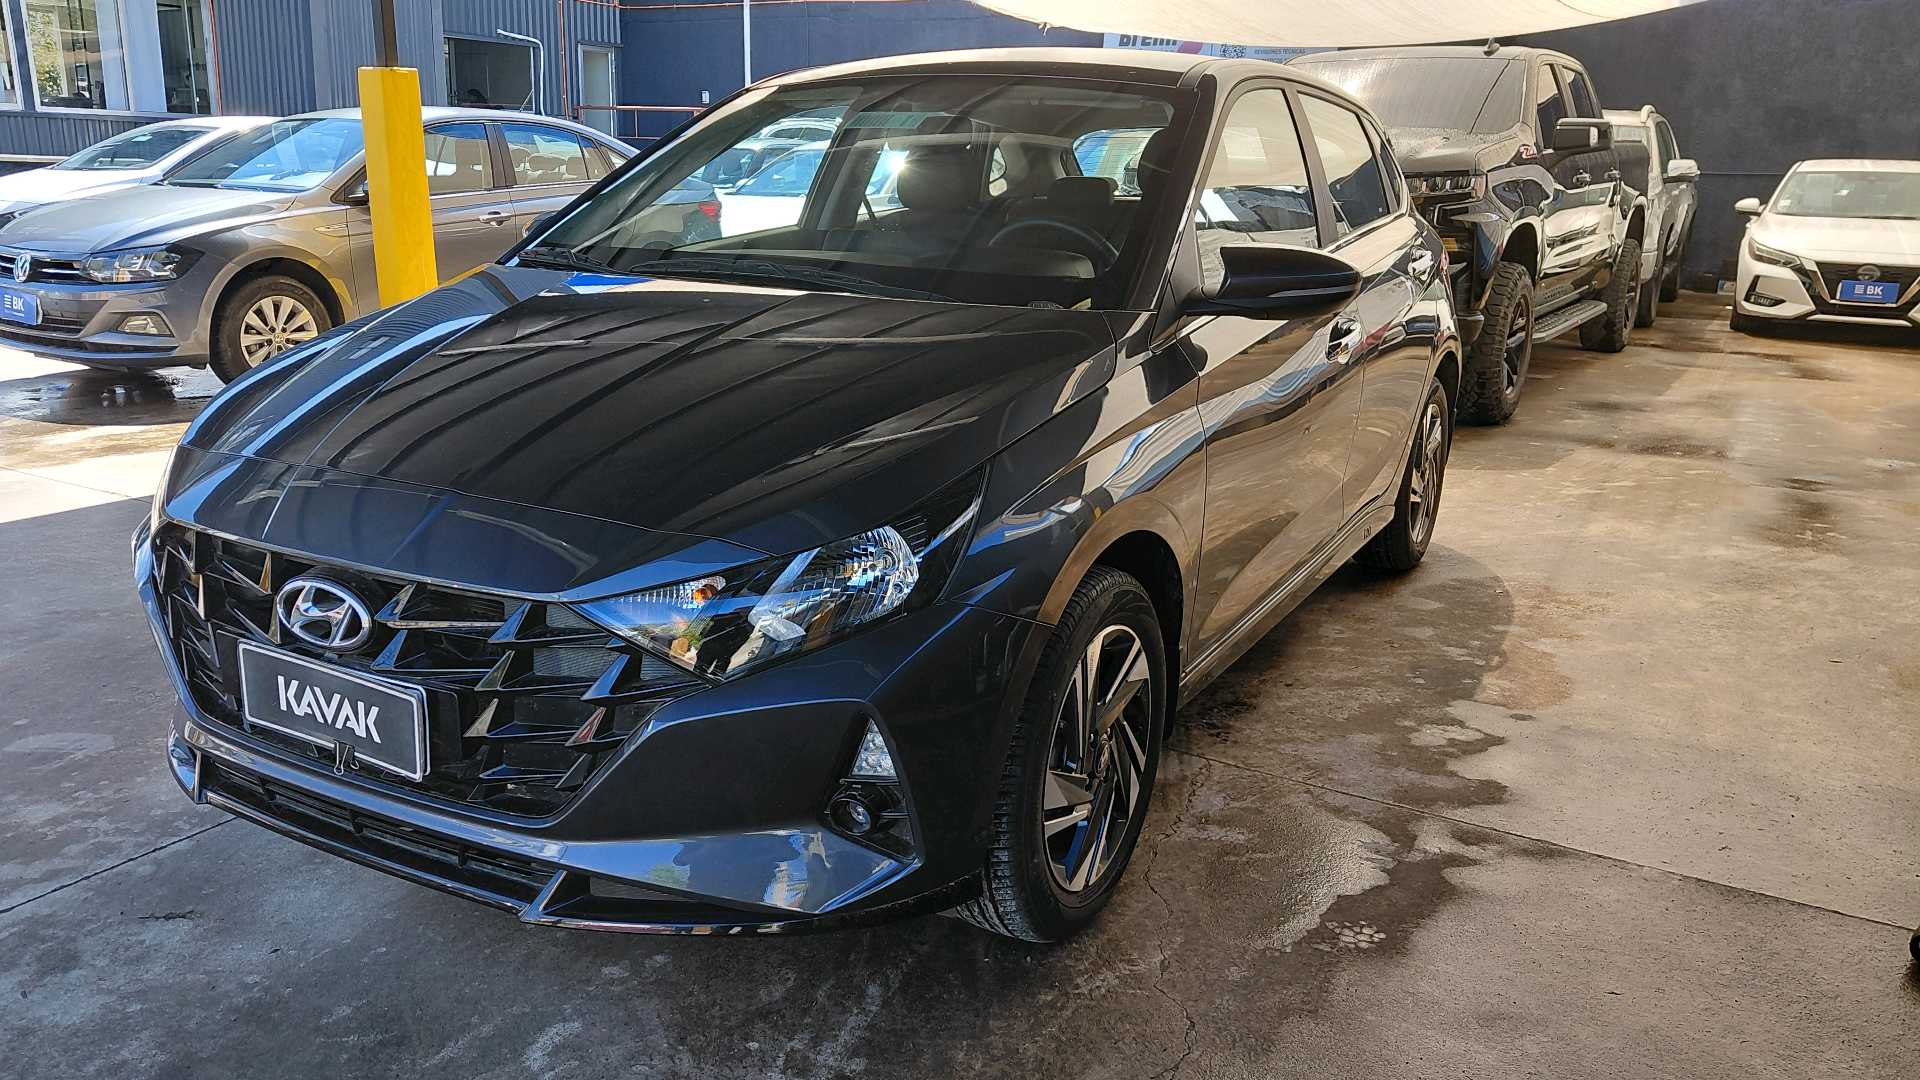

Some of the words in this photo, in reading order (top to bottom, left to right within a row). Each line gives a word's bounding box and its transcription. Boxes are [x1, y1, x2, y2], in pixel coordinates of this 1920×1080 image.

[1866, 285, 1884, 295] BK
[12, 296, 25, 311] BK
[277, 674, 382, 744] KAVAK
